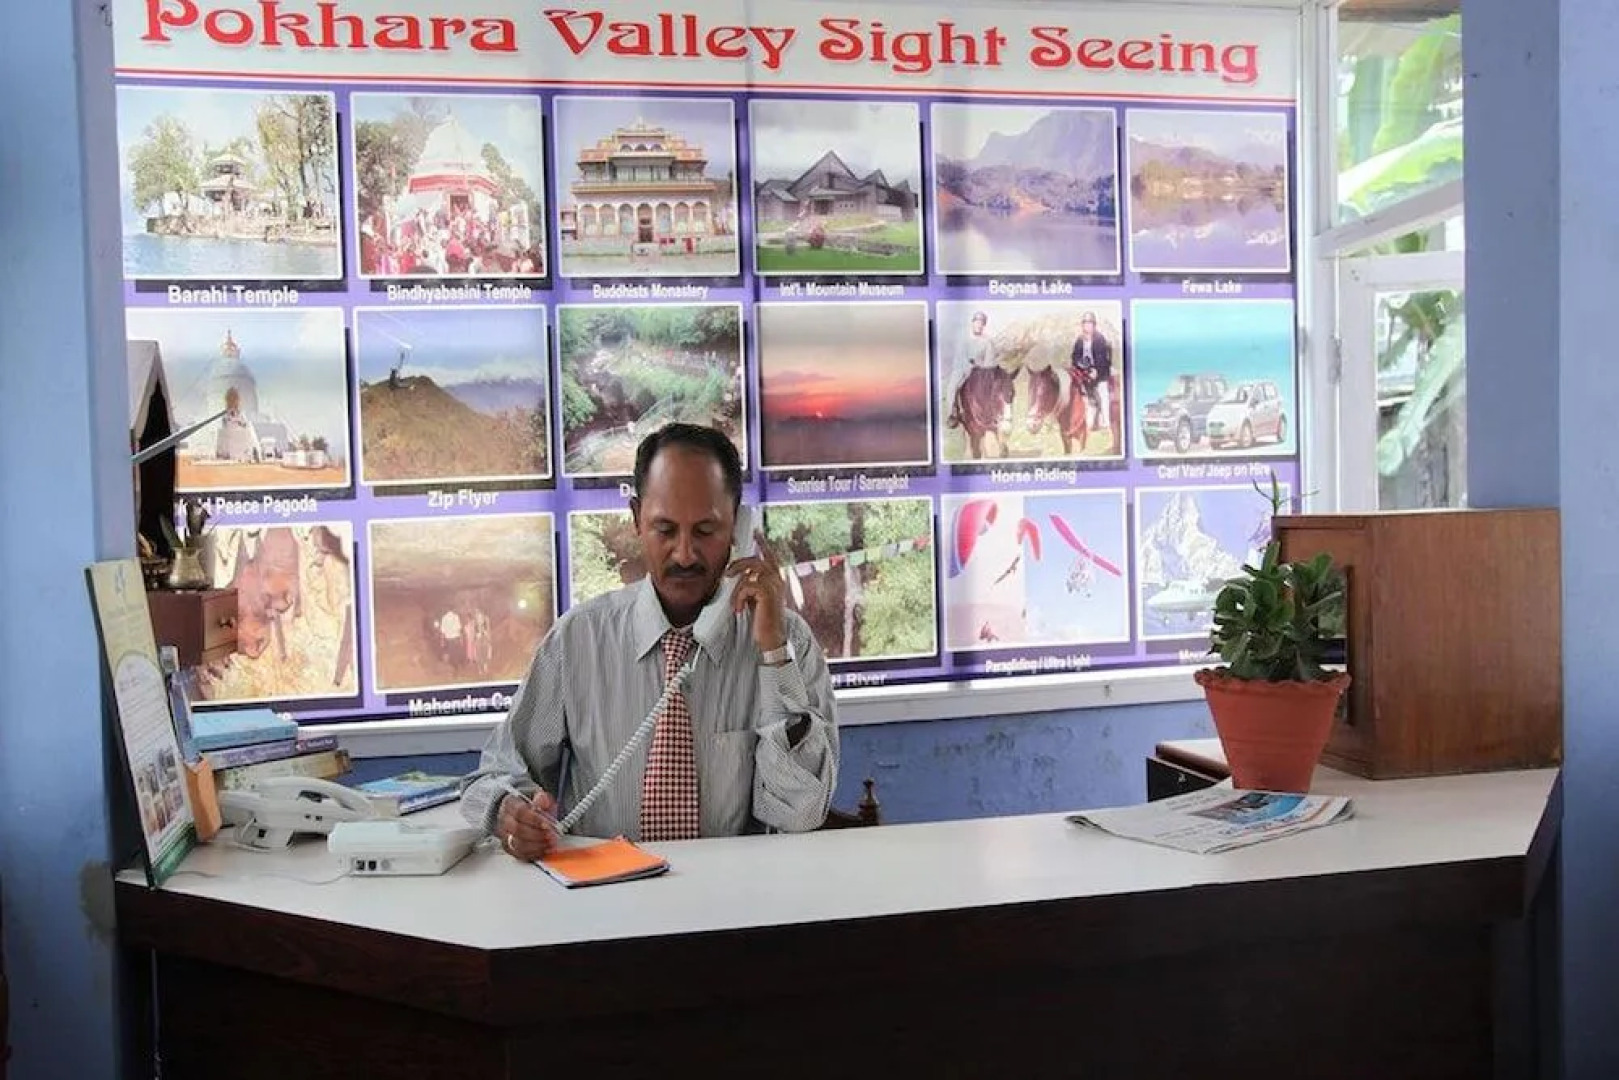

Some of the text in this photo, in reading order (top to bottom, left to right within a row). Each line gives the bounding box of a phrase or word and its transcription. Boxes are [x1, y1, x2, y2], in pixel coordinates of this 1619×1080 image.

[140, 0, 1259, 84] Pokhara Valley Sight Seeing
[167, 284, 299, 308] Barahi Temple
[387, 283, 532, 303] Bindhyabasini Temple
[650, 283, 709, 300] Monastery
[806, 281, 856, 297] Mountain
[858, 281, 905, 297] Museum
[988, 279, 1073, 298] Begnas Lake
[1181, 279, 1243, 294] Fewa Lake
[787, 476, 826, 494] Sunrise
[827, 475, 852, 492] Tour
[991, 467, 1076, 485] Horse Riding
[215, 496, 260, 515] Peace
[263, 494, 318, 517] Pagoda
[427, 488, 499, 510] Zip Flyer
[846, 672, 888, 687] River
[408, 691, 513, 716] Mahendra Ca
